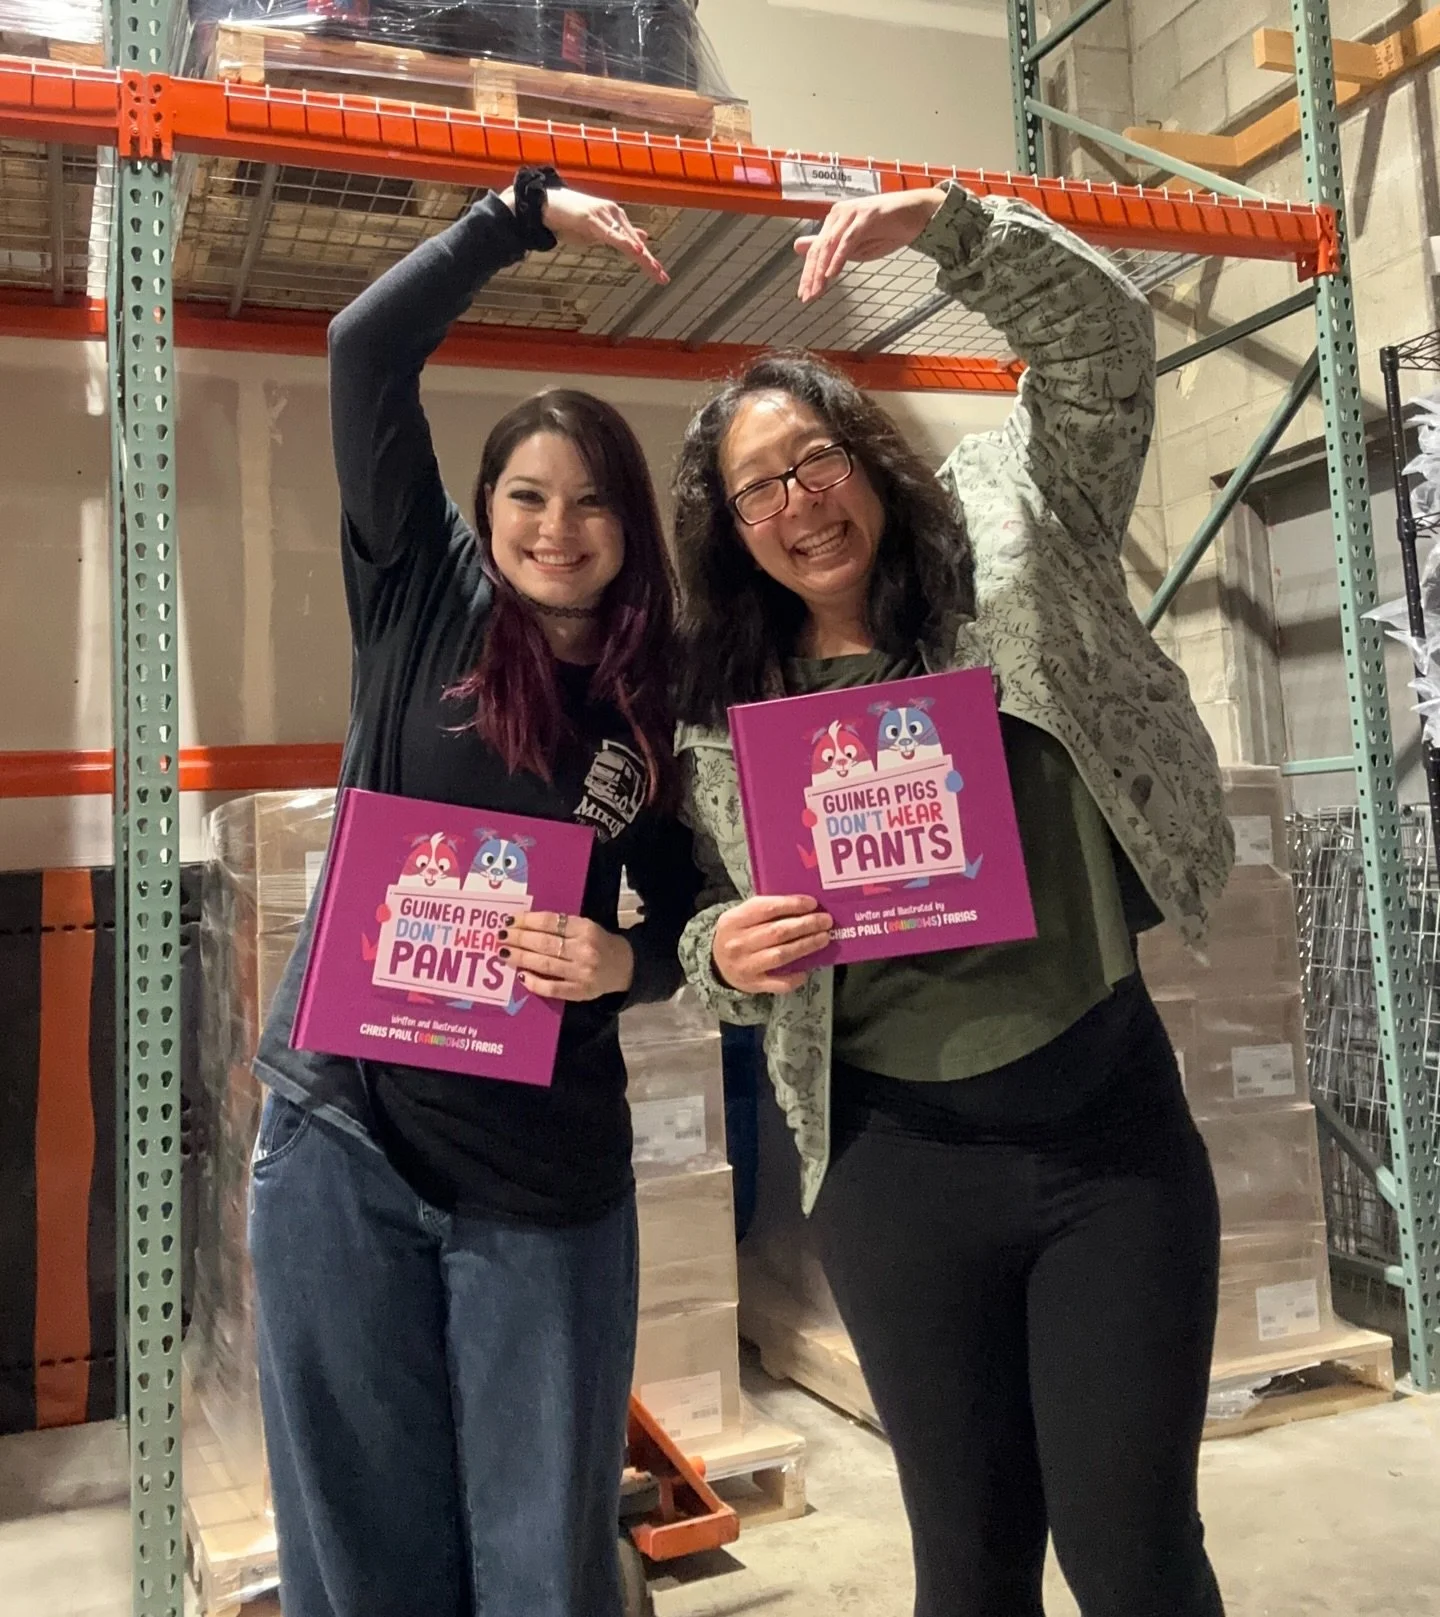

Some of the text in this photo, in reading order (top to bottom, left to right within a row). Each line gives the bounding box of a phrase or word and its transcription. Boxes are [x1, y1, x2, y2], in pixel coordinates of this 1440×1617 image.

[812, 169, 836, 181] 5000
[822, 779, 938, 814] GUINEA PIGS
[572, 794, 626, 839] MIKUS
[826, 801, 943, 838] DON'T WEAR
[829, 823, 953, 876] PANTS
[400, 897, 465, 924] GUINEA
[828, 926, 857, 941] CHRIS
[857, 923, 882, 937] PAUL
[943, 909, 978, 925] FARIAS
[882, 907, 896, 918] and
[935, 901, 945, 913] by
[396, 918, 502, 952] DON'T WEA
[389, 940, 507, 990] PANTS
[359, 1023, 388, 1038] CHRIS
[388, 1027, 412, 1042] PAUL
[470, 1039, 504, 1055] FARIAS
[417, 1018, 432, 1029] and
[468, 1026, 478, 1038] by
